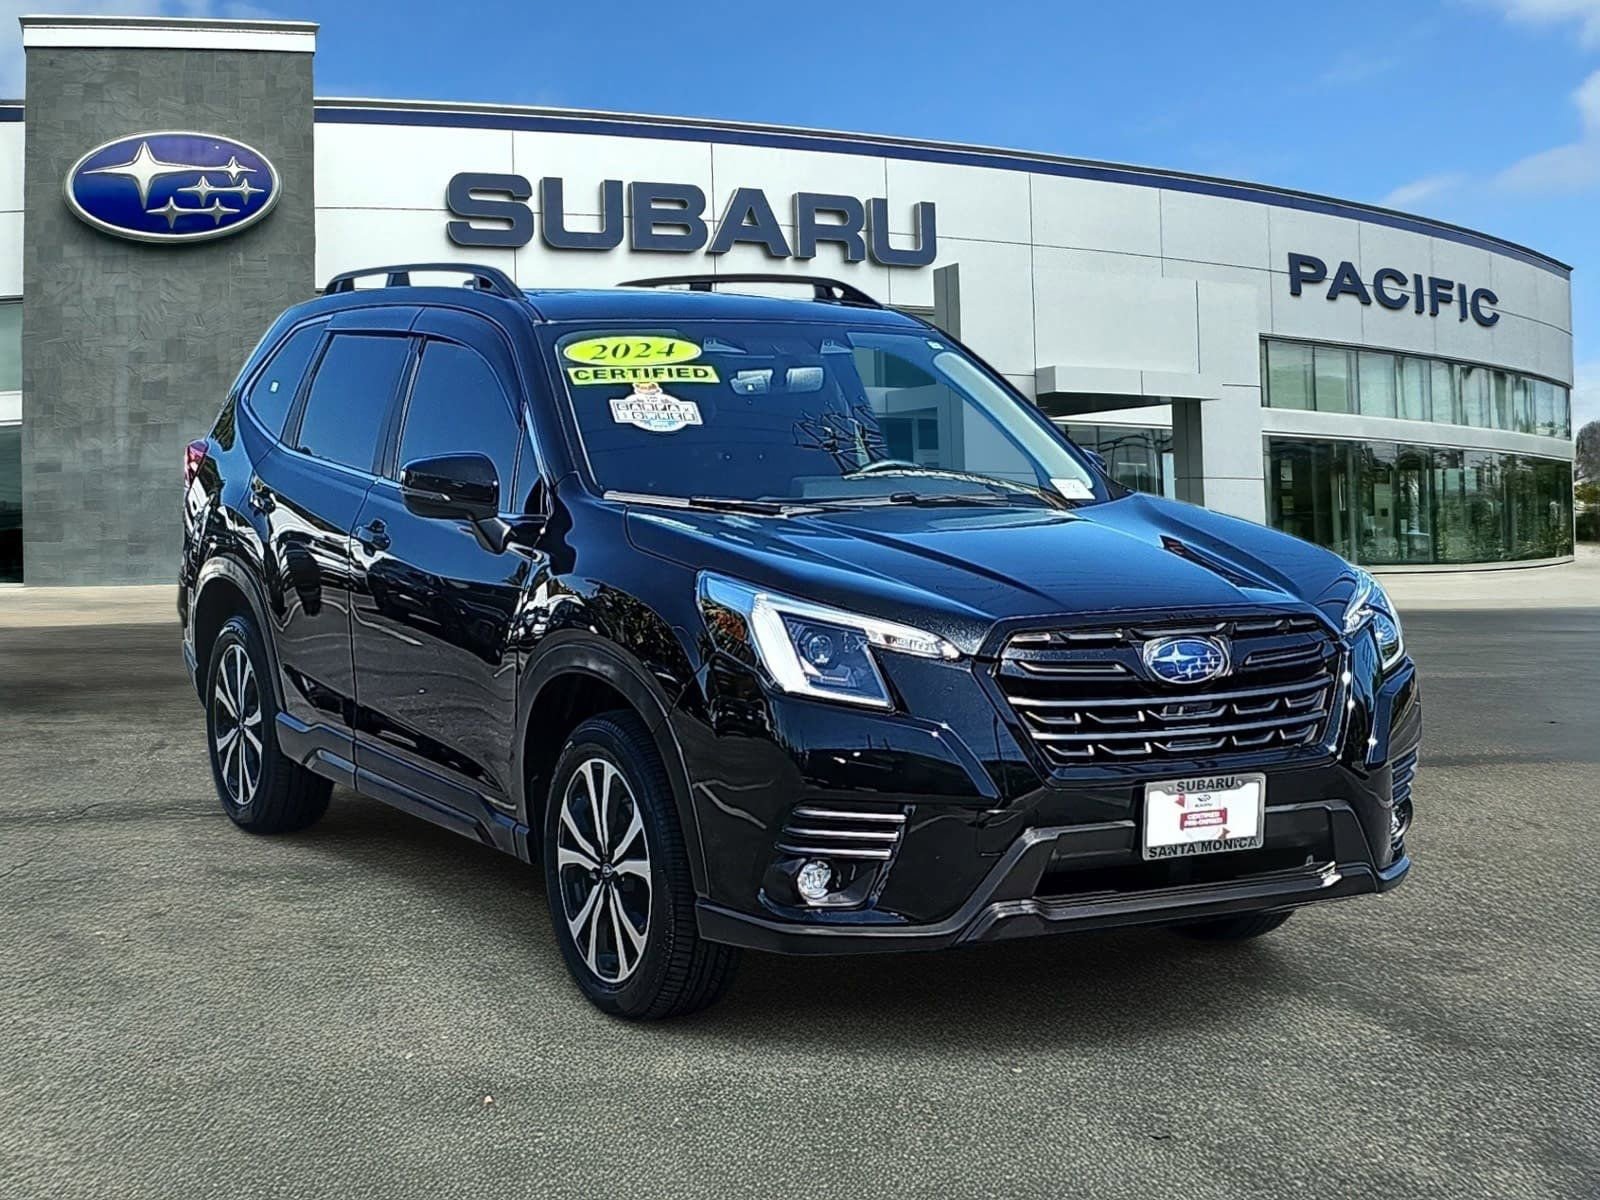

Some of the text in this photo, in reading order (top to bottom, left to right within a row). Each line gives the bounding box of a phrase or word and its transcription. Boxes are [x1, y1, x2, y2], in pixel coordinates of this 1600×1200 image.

[446, 171, 937, 267] SUBARU
[1288, 252, 1501, 327] PACIFIC
[590, 342, 676, 361] 2024
[573, 367, 710, 381] CERTIFIED
[1176, 776, 1235, 793] SUBARU
[1148, 837, 1259, 859] SANTA MONICA
